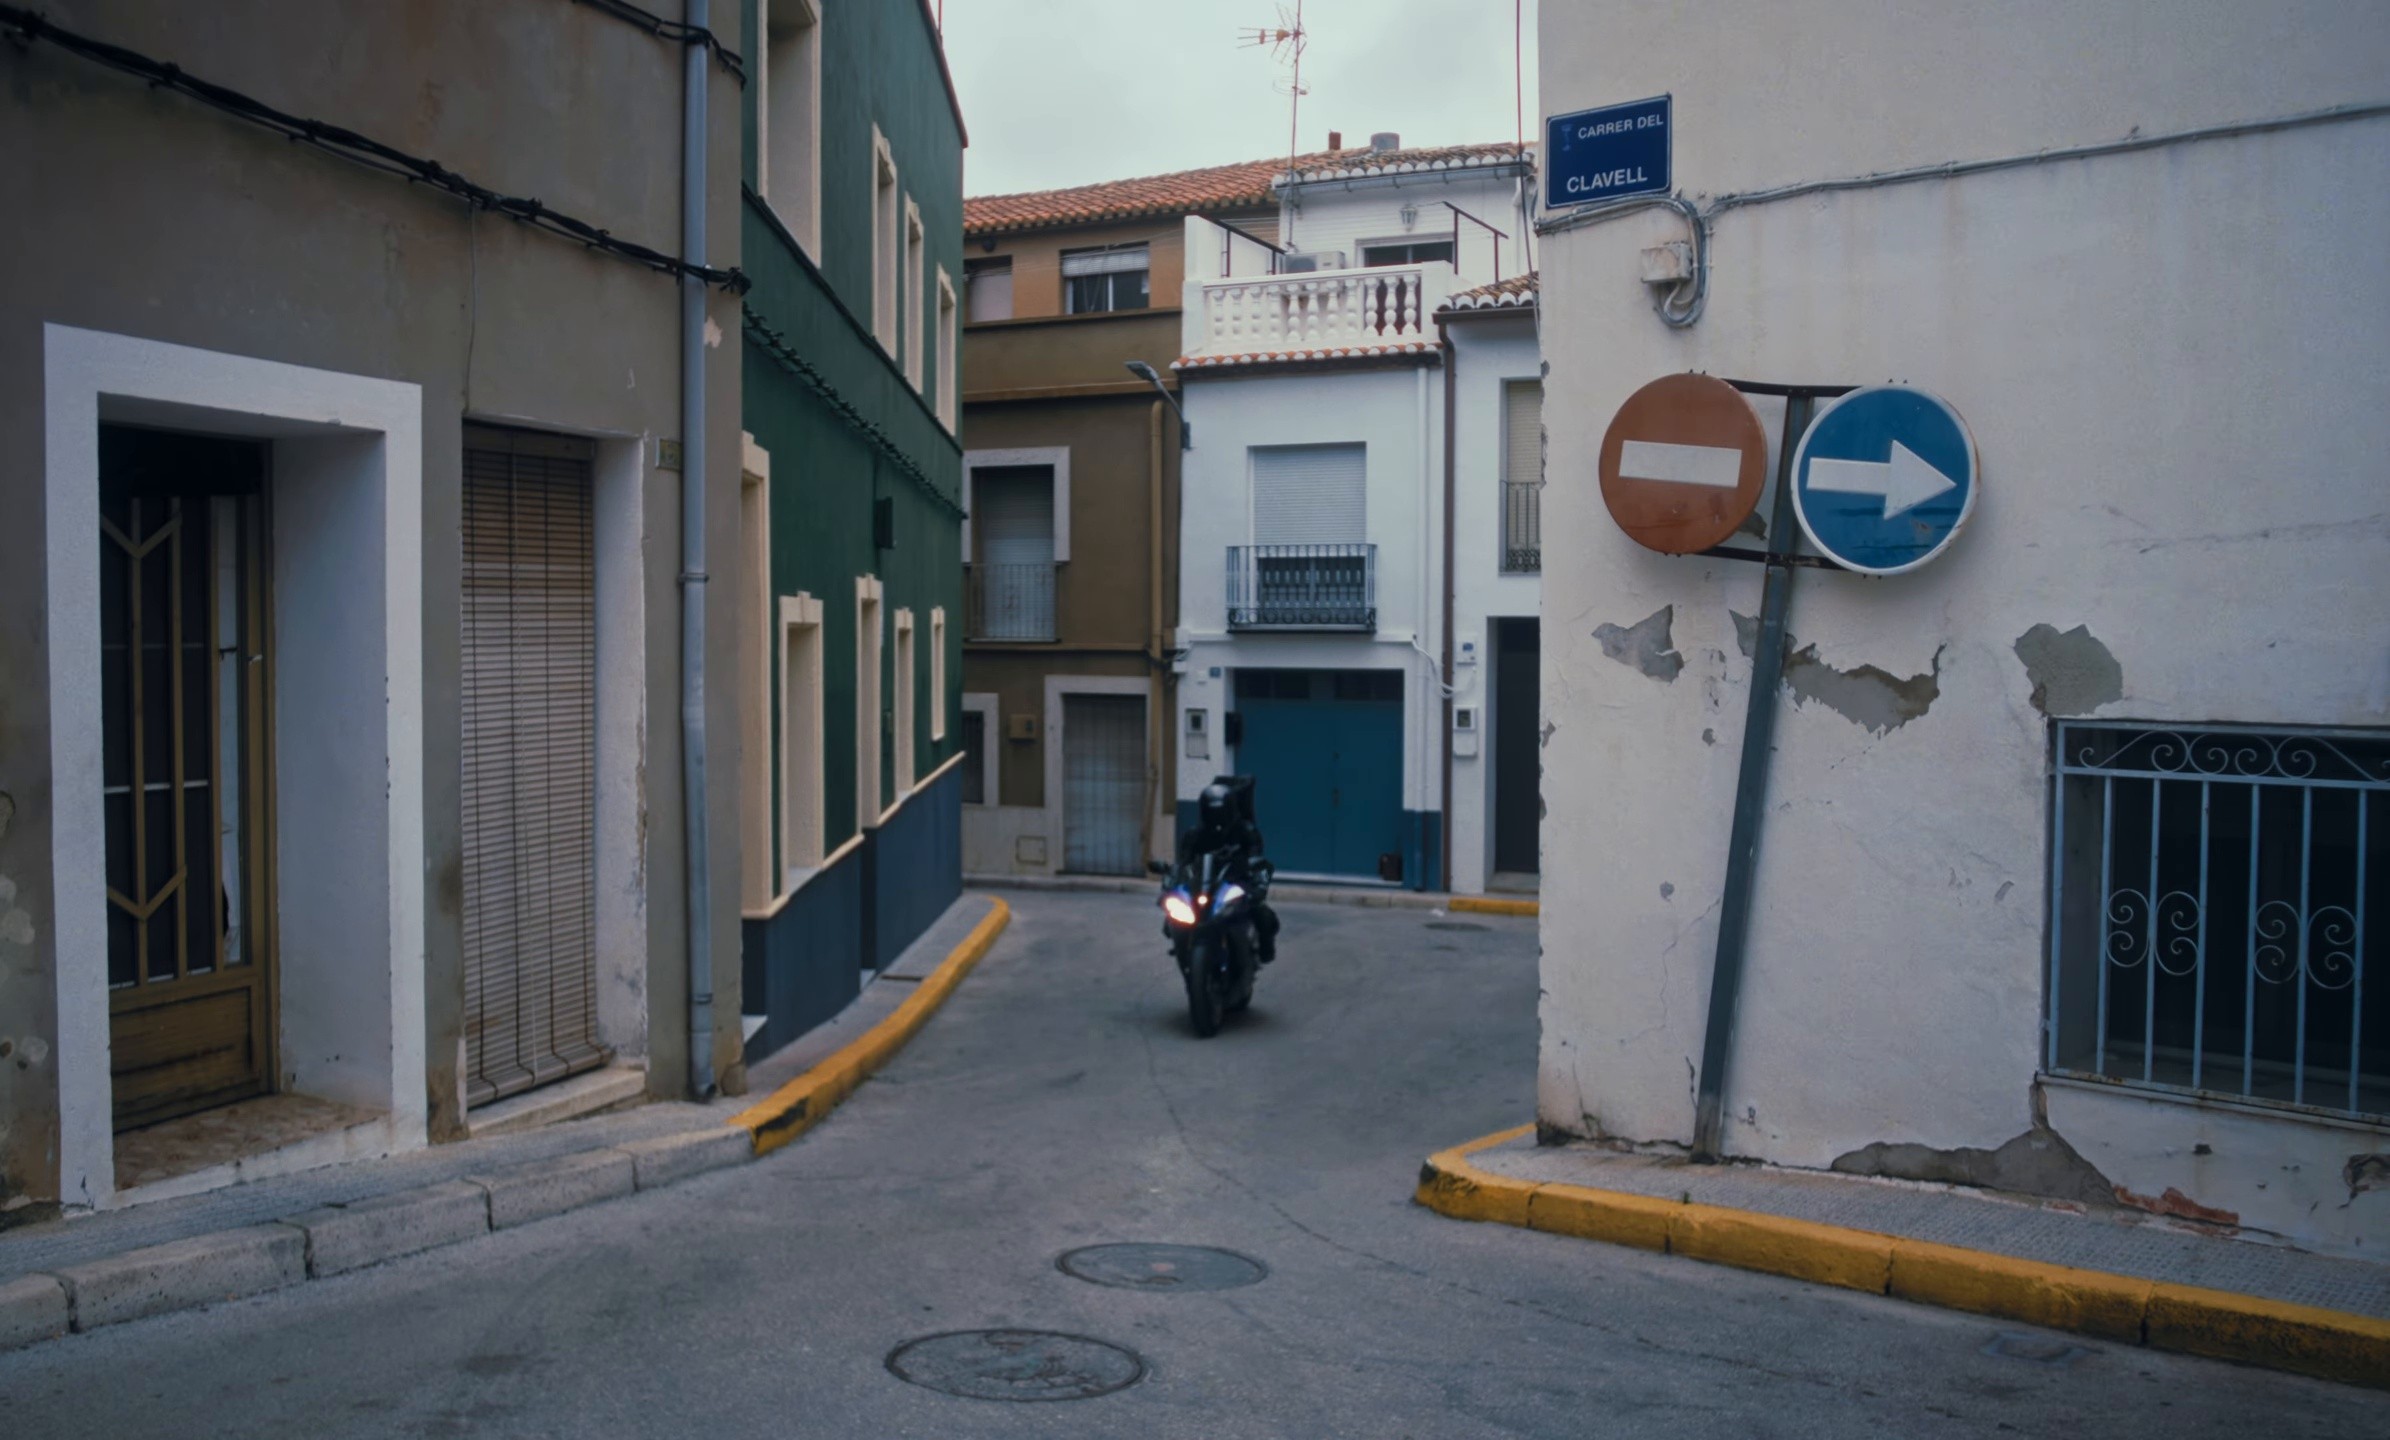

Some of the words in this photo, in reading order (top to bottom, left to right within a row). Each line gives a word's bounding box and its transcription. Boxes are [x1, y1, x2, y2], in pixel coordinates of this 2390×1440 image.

[1578, 119, 1633, 139] CARRER
[1637, 114, 1664, 129] DEL
[1566, 166, 1648, 193] CLAVELL
